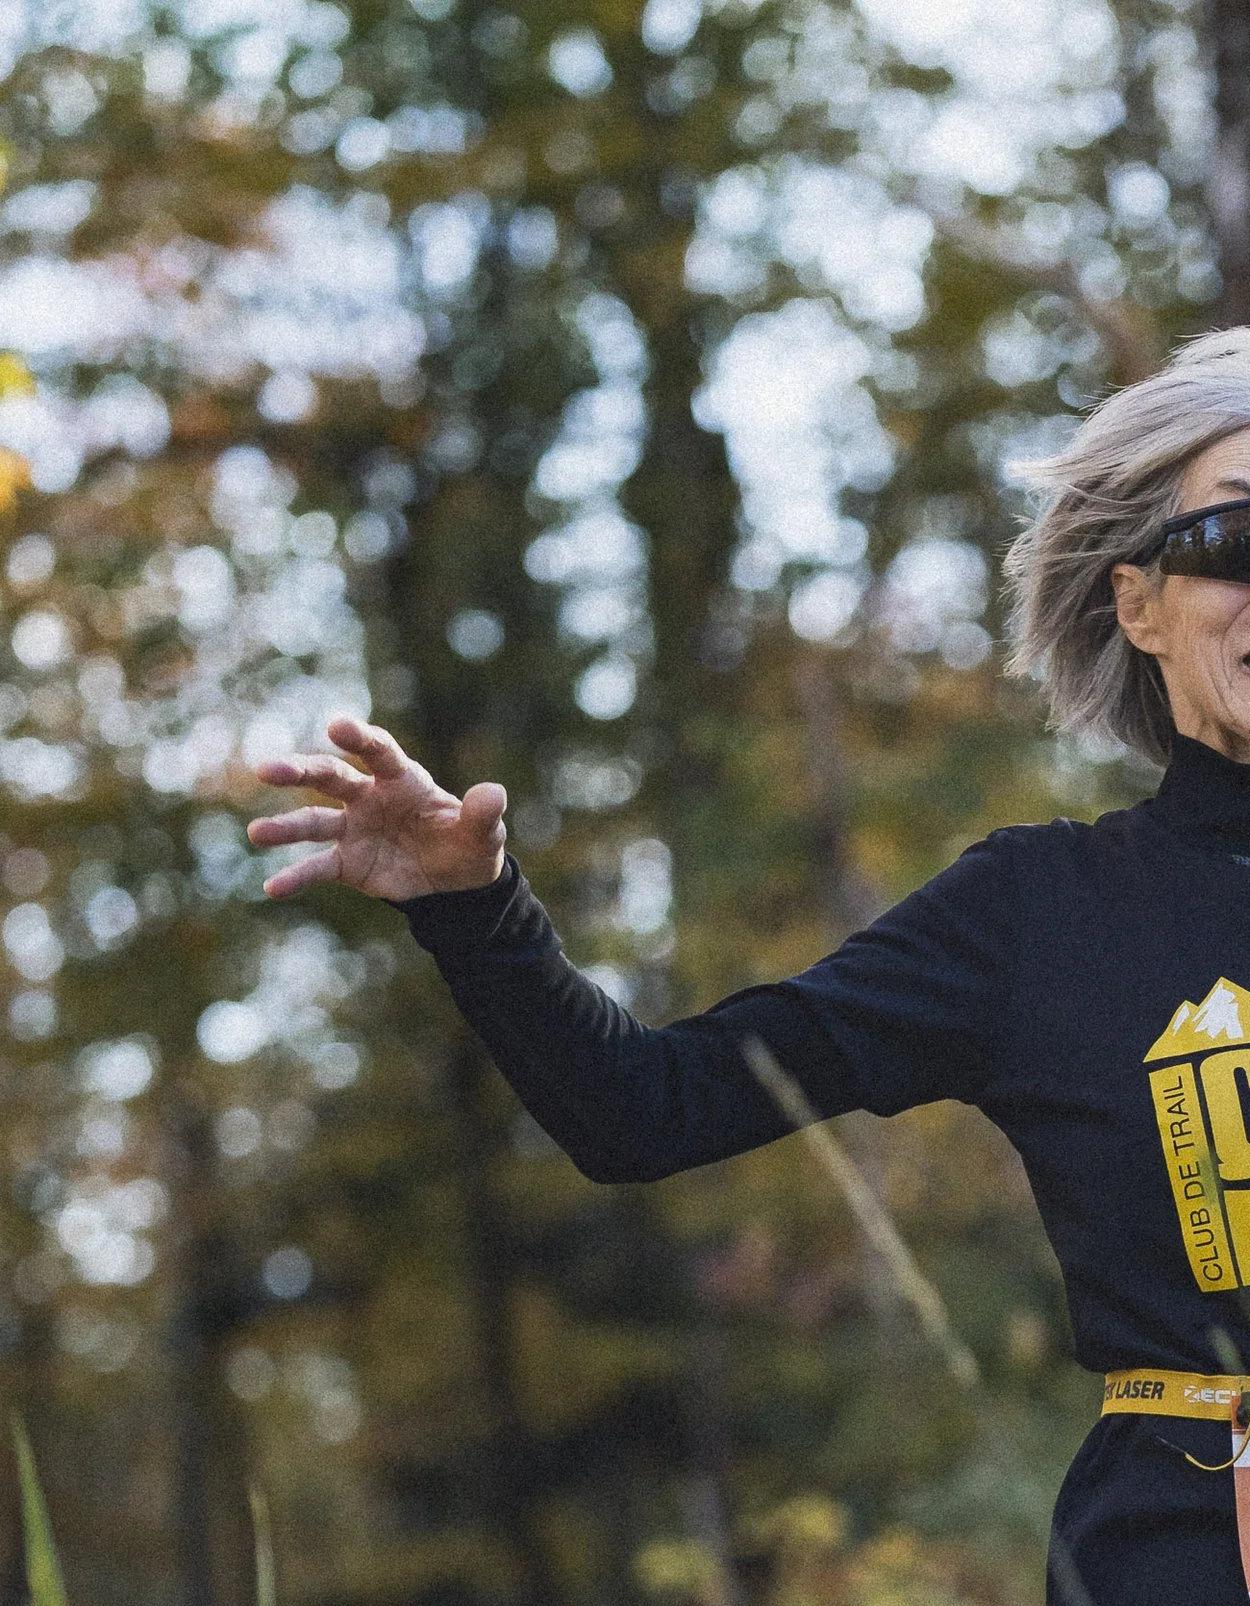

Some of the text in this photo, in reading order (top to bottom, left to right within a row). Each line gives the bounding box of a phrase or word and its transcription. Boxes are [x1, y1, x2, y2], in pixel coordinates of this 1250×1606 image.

[1162, 1075, 1224, 1282] CLUB DE TRAIL
[1115, 1380, 1165, 1400] LASER
